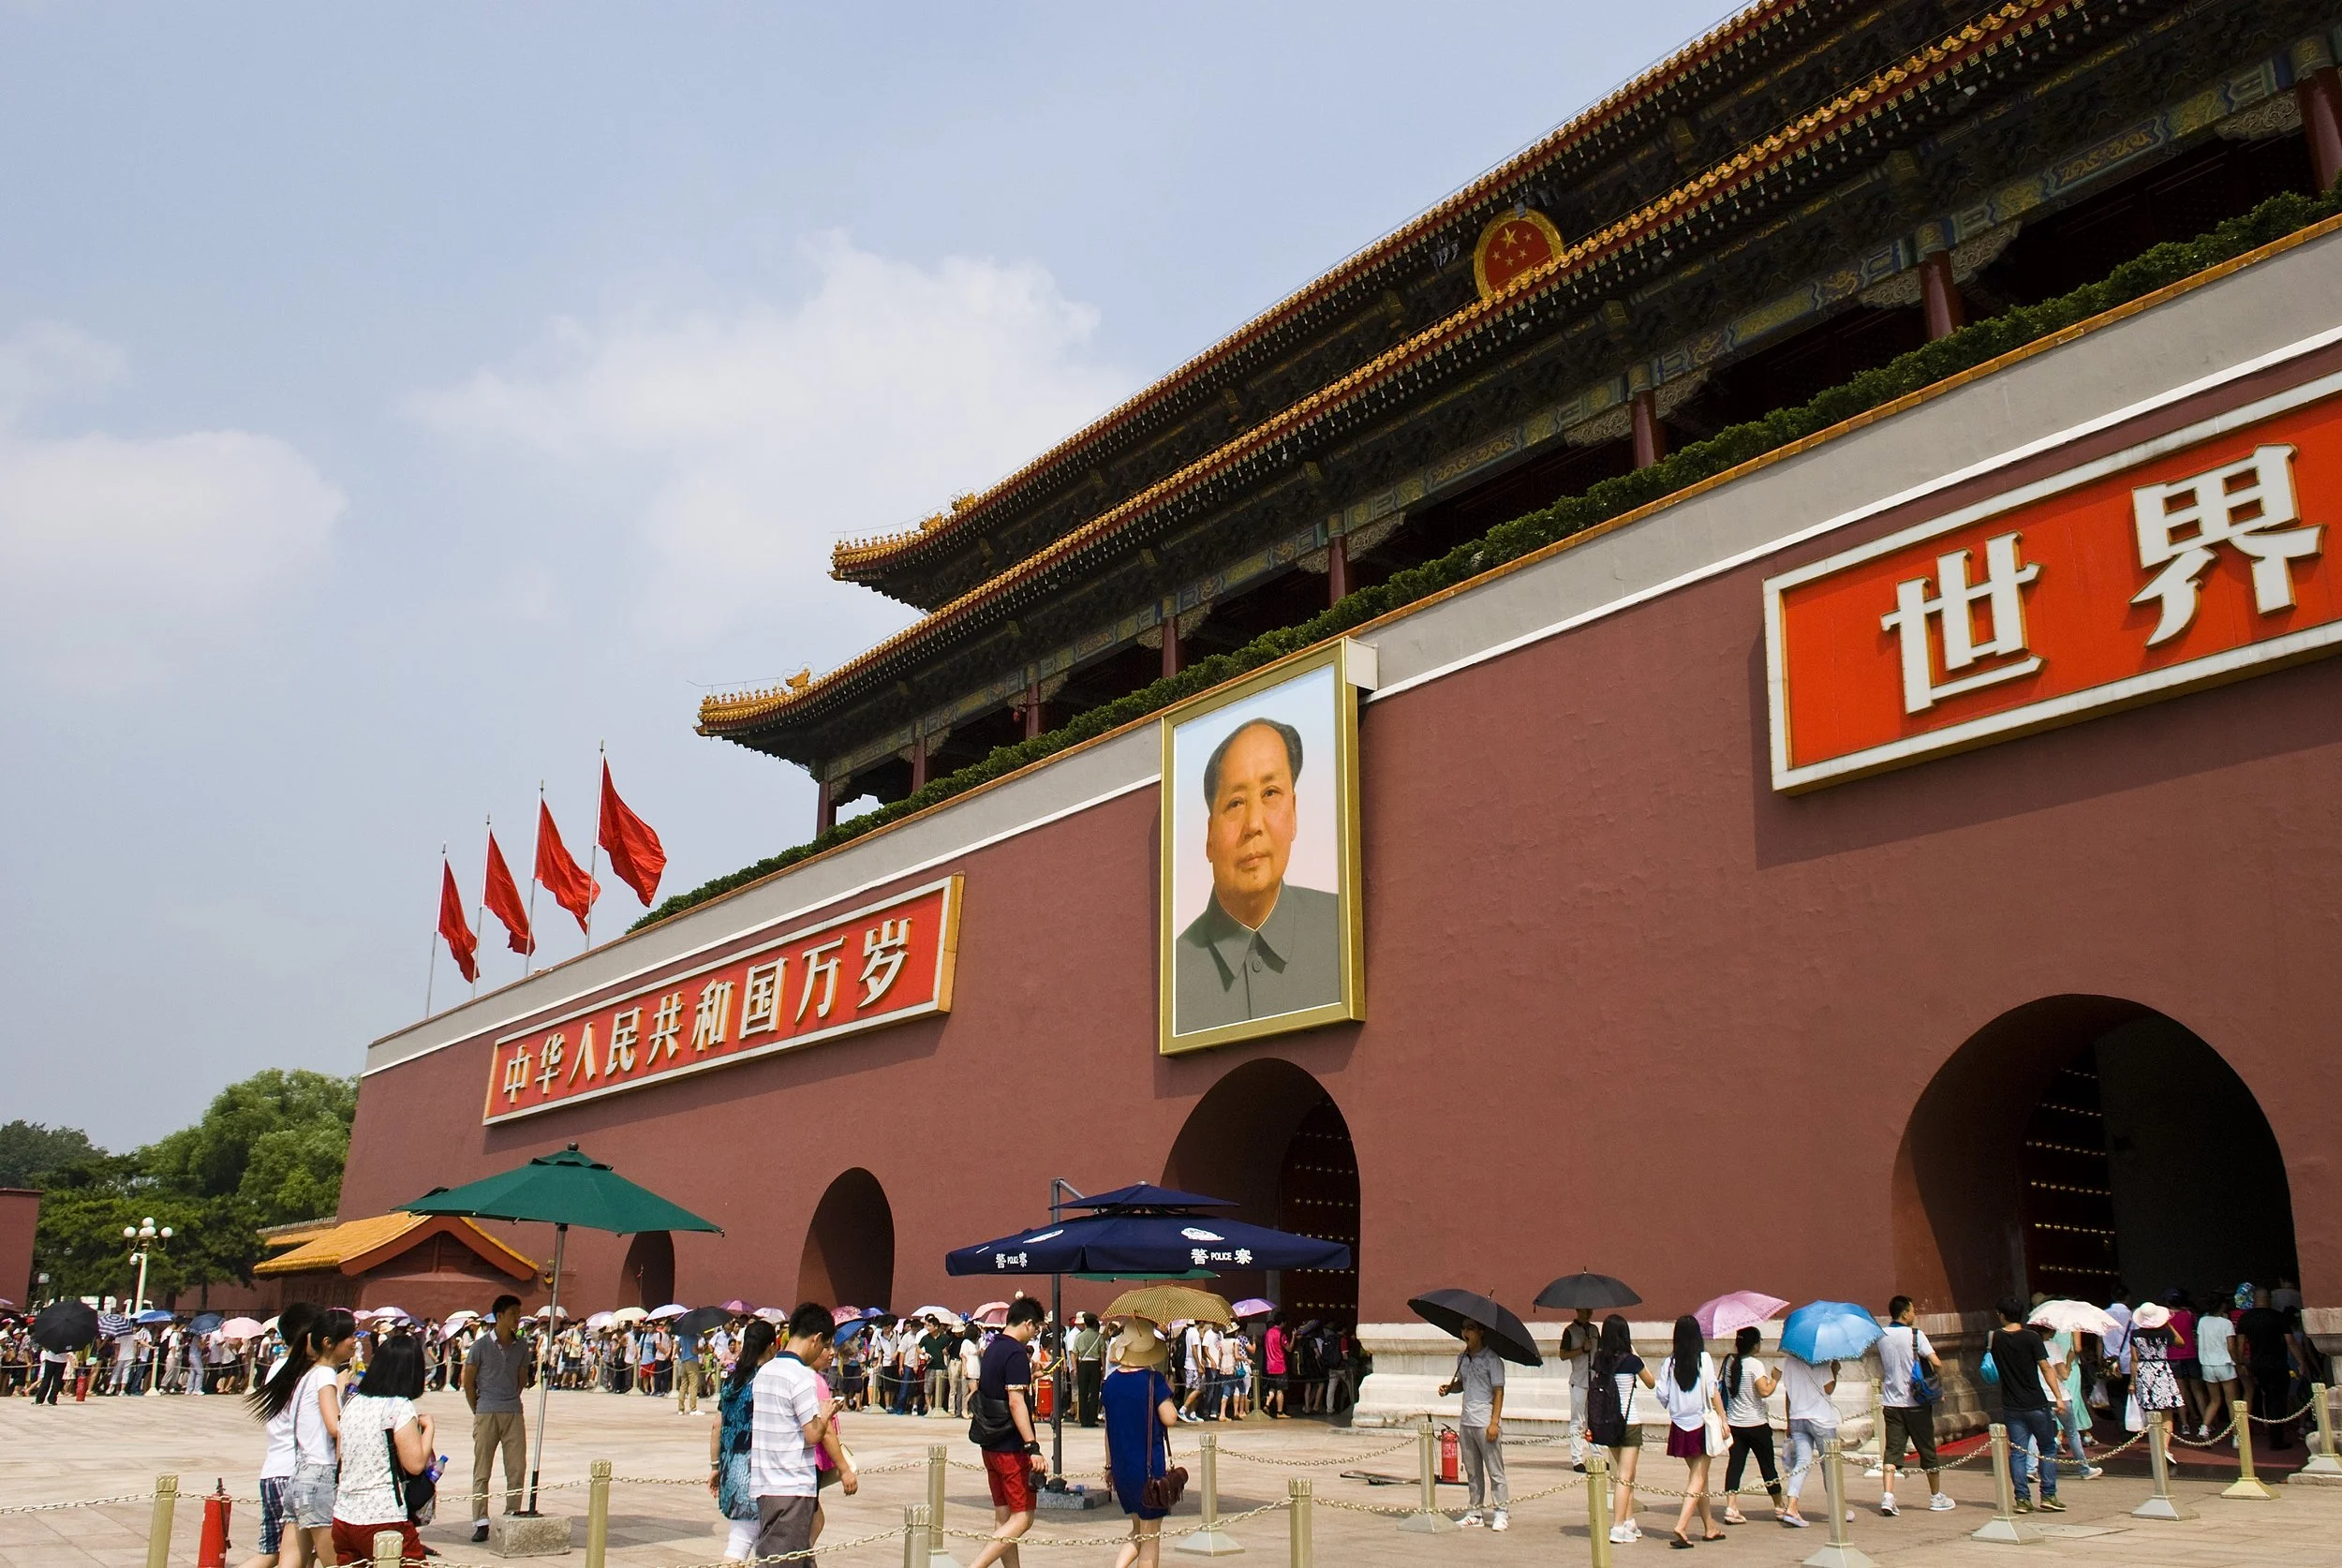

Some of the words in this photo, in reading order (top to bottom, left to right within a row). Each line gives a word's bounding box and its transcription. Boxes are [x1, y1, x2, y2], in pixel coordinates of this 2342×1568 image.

[1880, 443, 2328, 715] 世界
[503, 917, 912, 1104] 中华人民共和国万岁
[1191, 1248, 1209, 1265] 警
[1210, 1251, 1233, 1261] POLICE
[1234, 1248, 1253, 1265] 察
